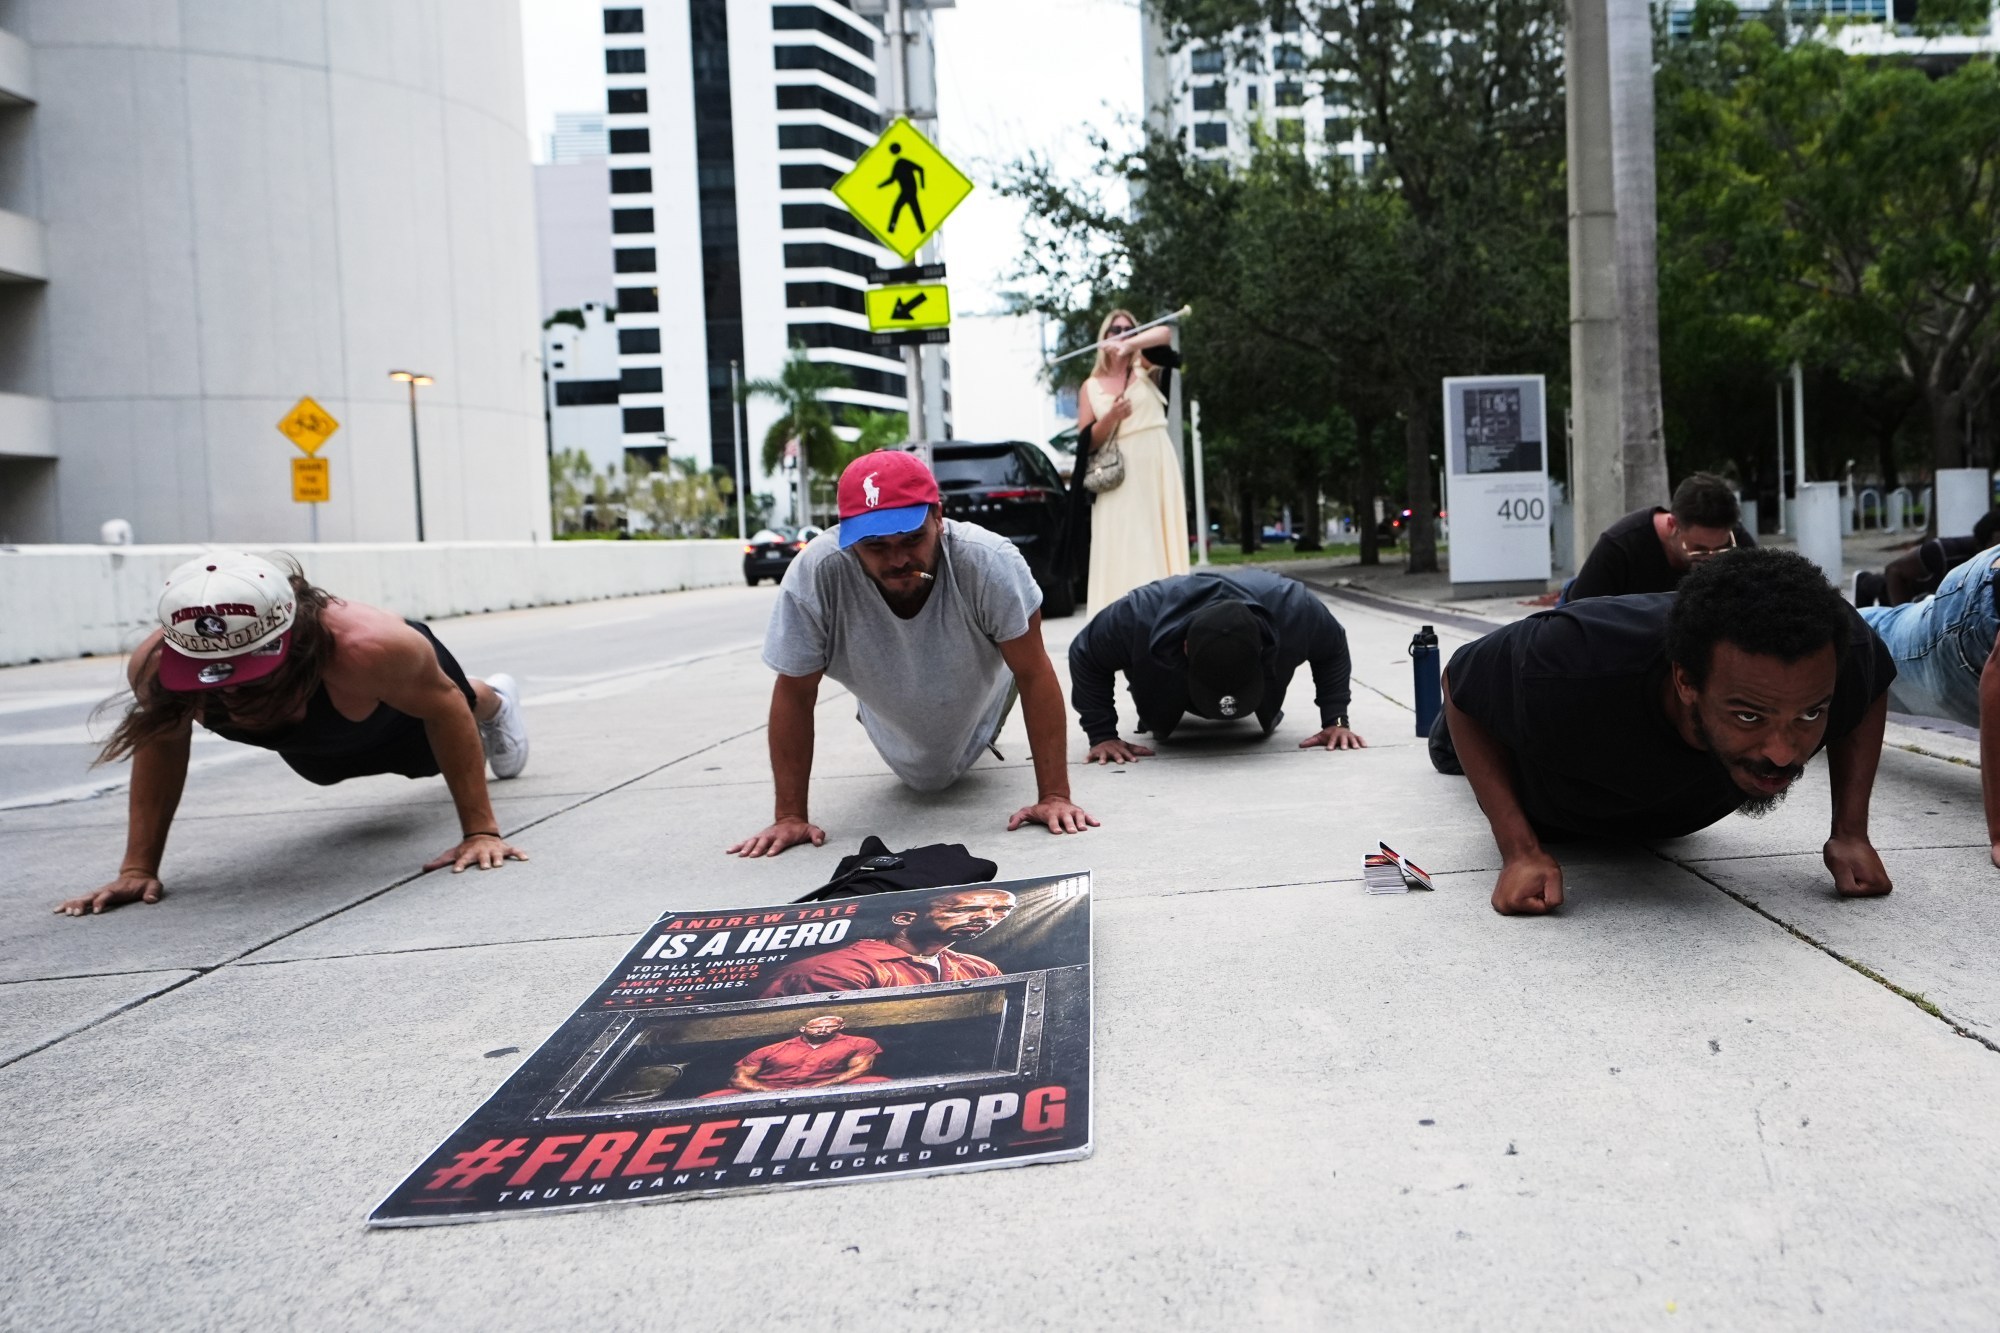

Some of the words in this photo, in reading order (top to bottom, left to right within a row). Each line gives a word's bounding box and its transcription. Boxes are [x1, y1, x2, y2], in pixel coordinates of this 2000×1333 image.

[1497, 498, 1544, 521] 400
[215, 602, 257, 618] STATE
[667, 912, 785, 930] ANDREW
[797, 904, 860, 920] TATE
[641, 933, 698, 960] IS
[693, 931, 731, 958] A
[735, 919, 852, 955] HERO
[626, 973, 662, 981] WHO
[668, 969, 702, 978] HAS
[707, 964, 760, 975] SAVED
[633, 962, 700, 973] TOTALLY
[705, 954, 789, 968] INNOCENT
[610, 986, 660, 996] FROM
[665, 980, 750, 993] SUICIDES.
[617, 976, 706, 988] AMERICAN
[712, 971, 761, 982] LIVES
[425, 1085, 1067, 1190] #FREETHETOPG
[498, 1183, 605, 1202] TRUTH
[628, 1170, 727, 1190] CAN'T
[749, 1165, 785, 1178] BE
[809, 1149, 932, 1172] LOCKED
[955, 1143, 998, 1157] UP.
